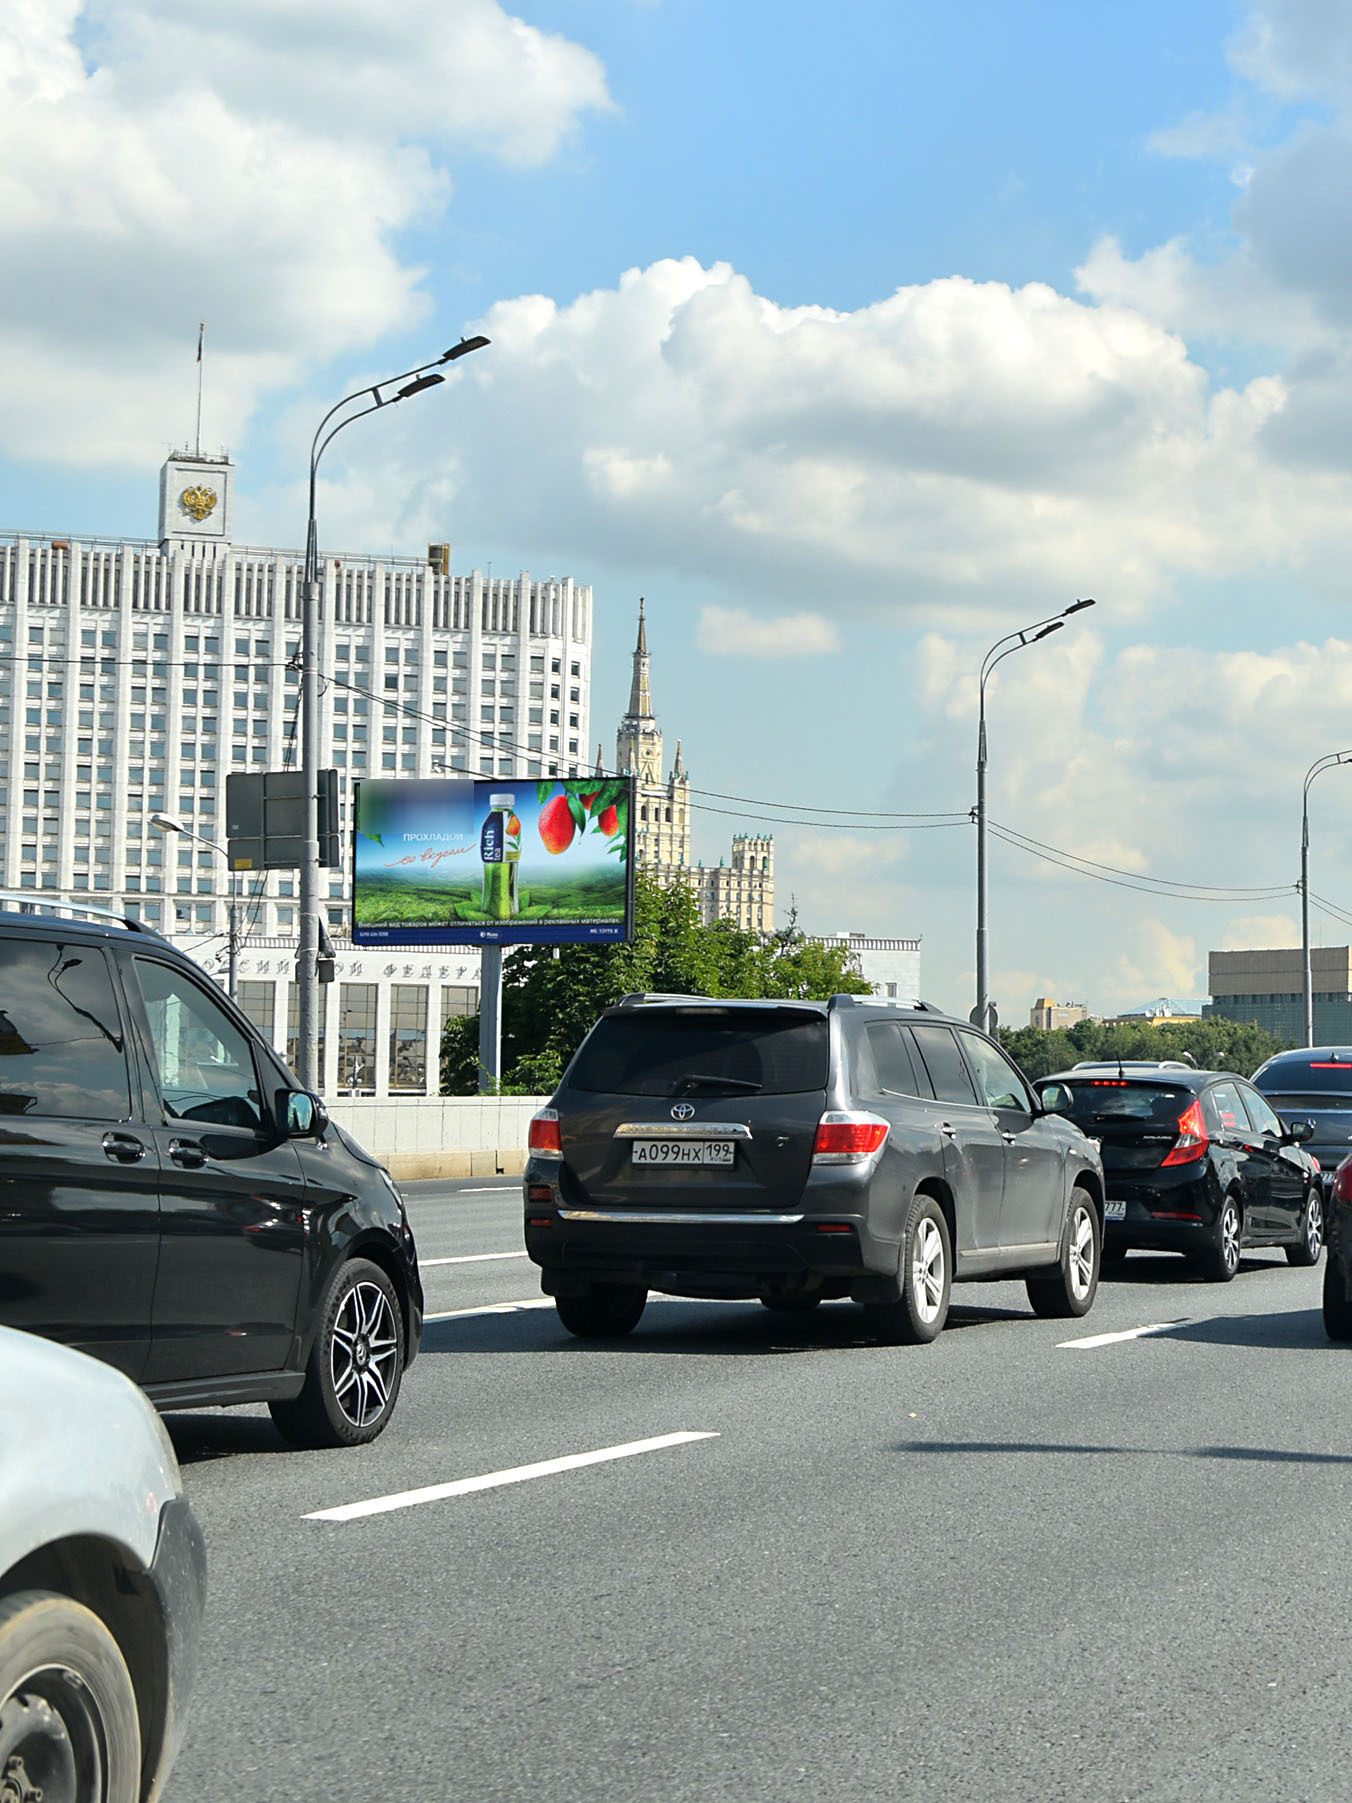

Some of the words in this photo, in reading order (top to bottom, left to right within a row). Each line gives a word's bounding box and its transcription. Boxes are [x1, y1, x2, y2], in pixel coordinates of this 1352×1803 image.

[484, 829, 494, 860] Rich
[638, 1144, 702, 1161] А099НХ
[706, 1144, 730, 1157] 199
